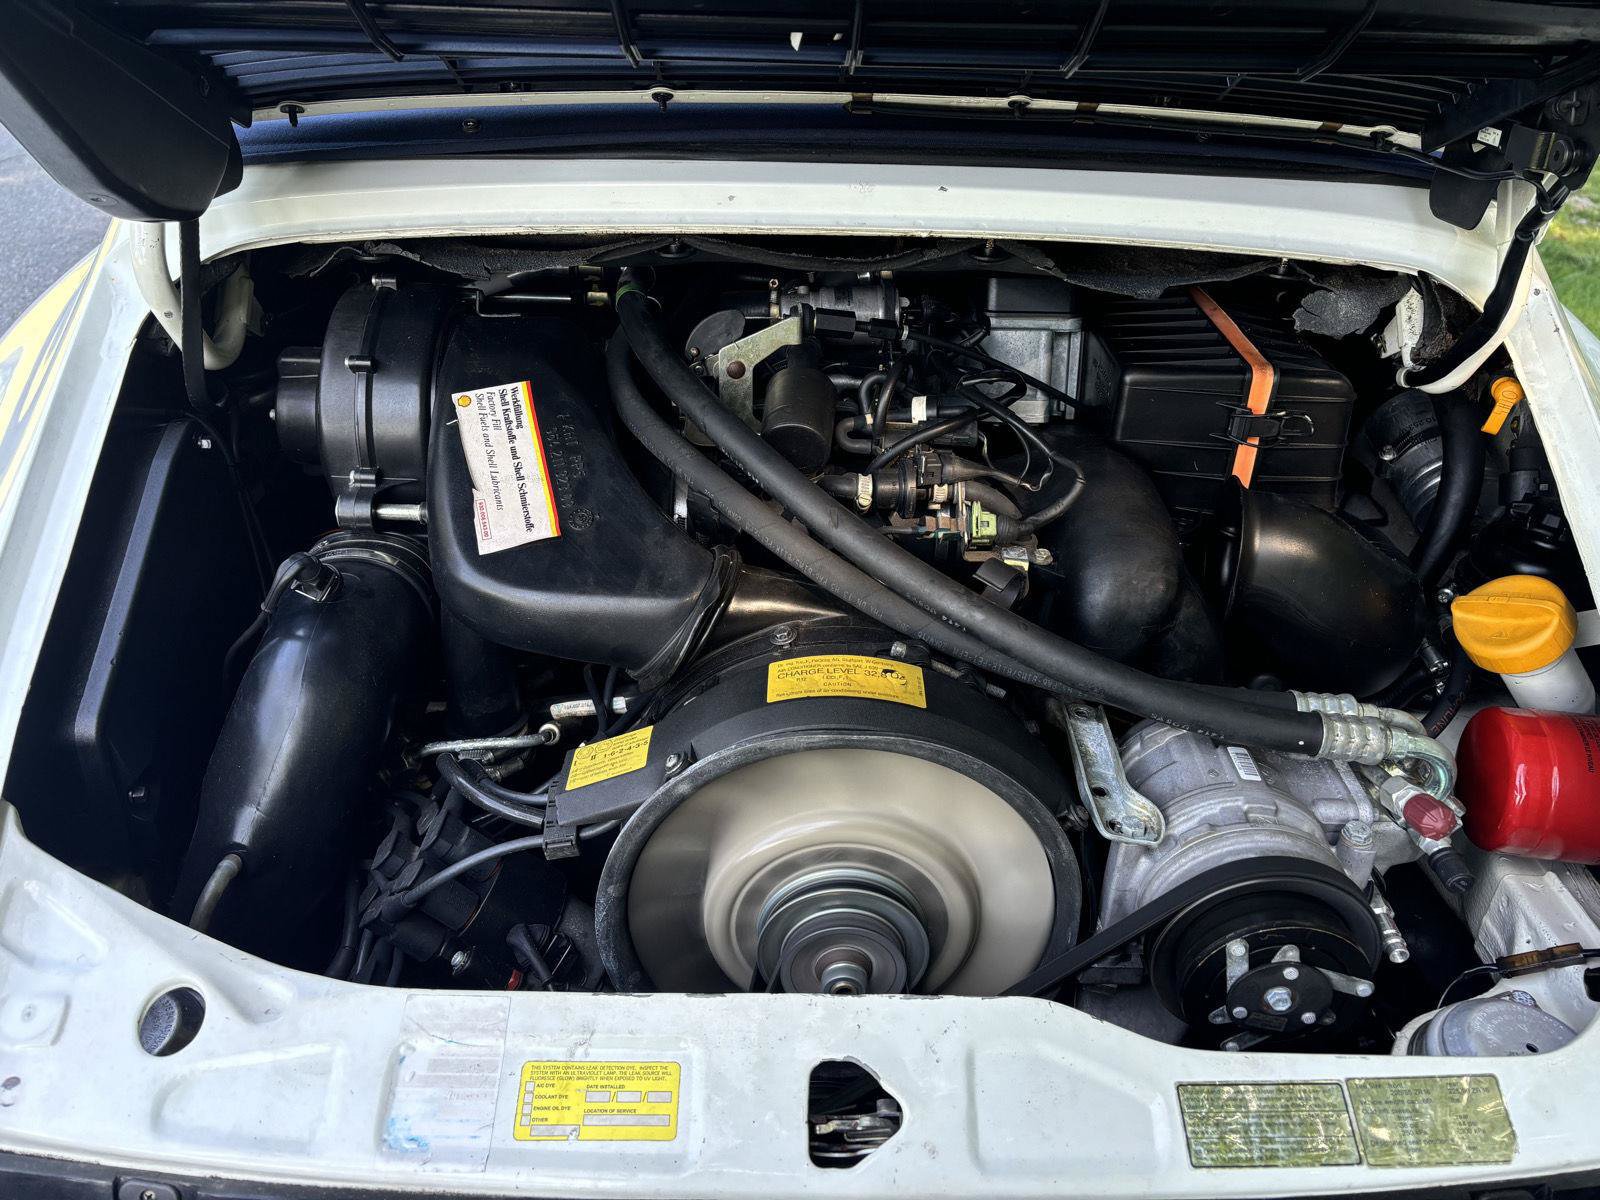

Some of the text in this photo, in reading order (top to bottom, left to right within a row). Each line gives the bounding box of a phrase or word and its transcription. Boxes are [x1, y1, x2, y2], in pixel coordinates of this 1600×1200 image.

[486, 391, 502, 431] Factory Fill
[510, 386, 524, 429] Werkfüllung
[474, 393, 504, 511] Shell Fuels and Shell Lubricants
[498, 389, 535, 533] Shell Kraftstoffe und Shell Schmierstoffe
[777, 667, 825, 680] CHARGE
[826, 667, 860, 675] LEVEL
[604, 740, 649, 758] 1-6-2-4-3-5
